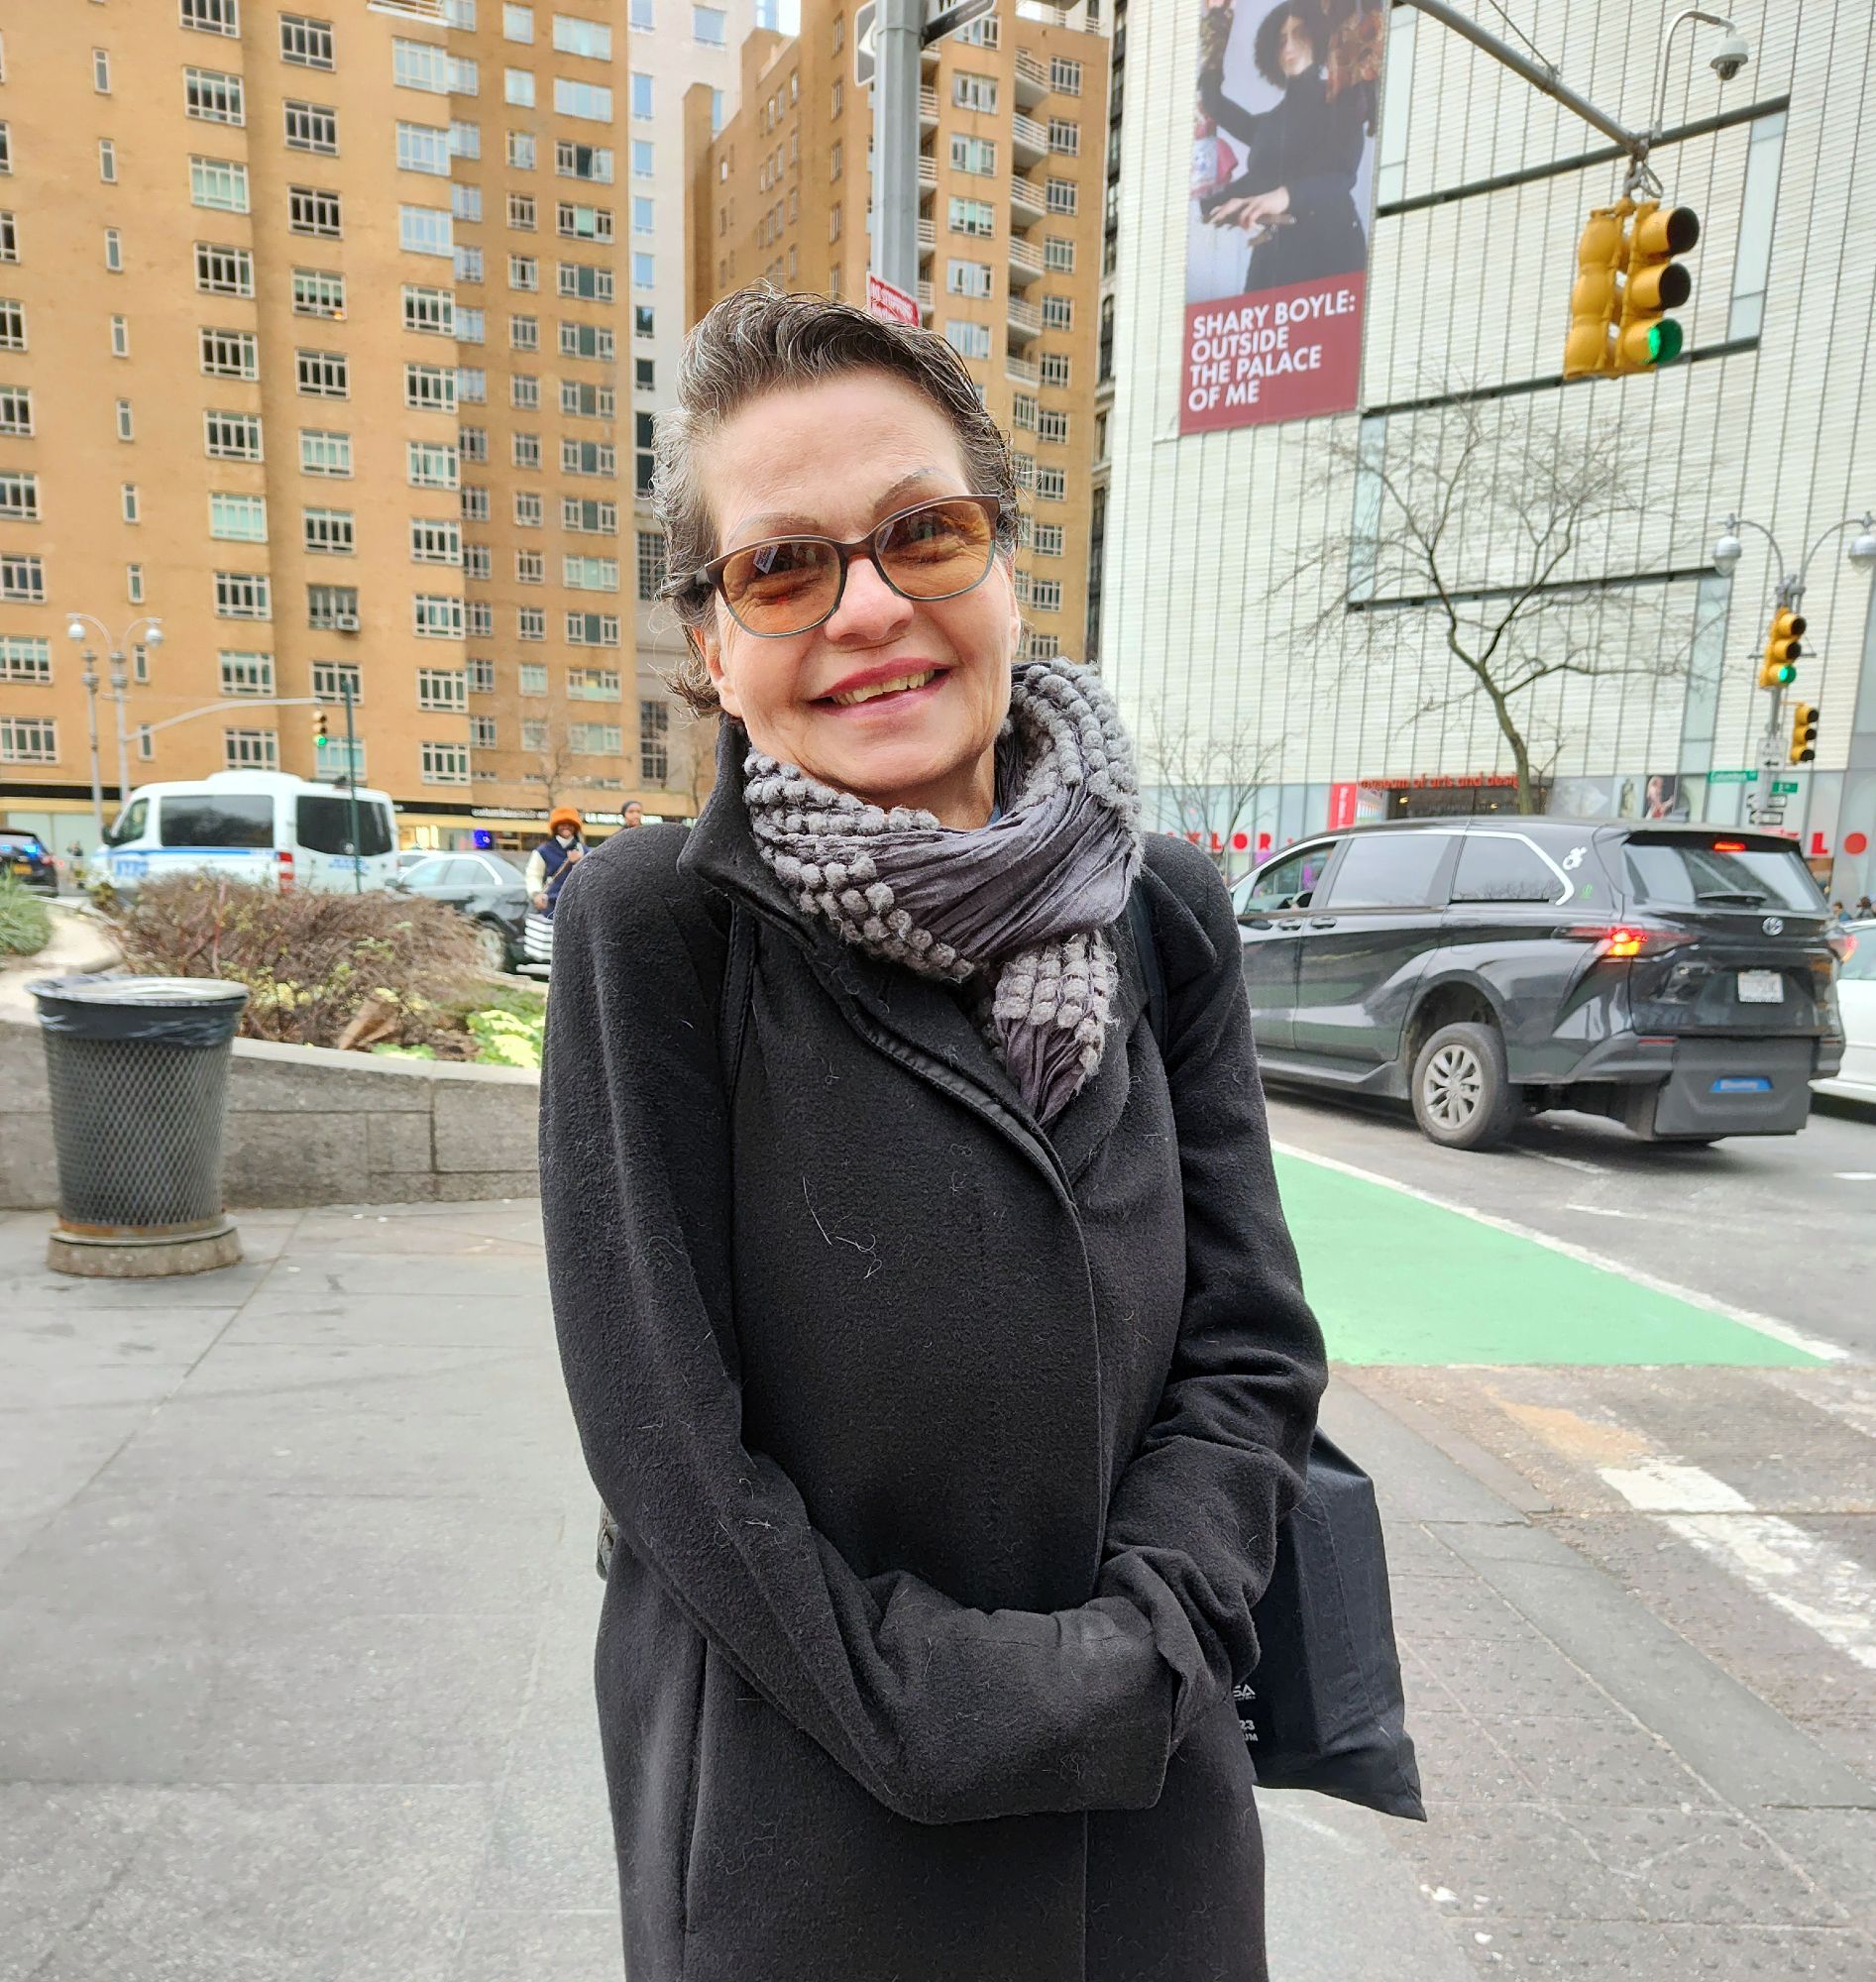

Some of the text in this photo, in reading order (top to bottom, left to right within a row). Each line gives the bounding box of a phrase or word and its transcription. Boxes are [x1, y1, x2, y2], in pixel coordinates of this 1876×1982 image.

[1192, 289, 1356, 339] SHARY BOYLE:
[1191, 326, 1290, 364] OUTSIDE
[1189, 345, 1323, 387] THE PALACE
[1188, 379, 1261, 411] OF ME
[1361, 771, 1519, 790] museum of arts and desig
